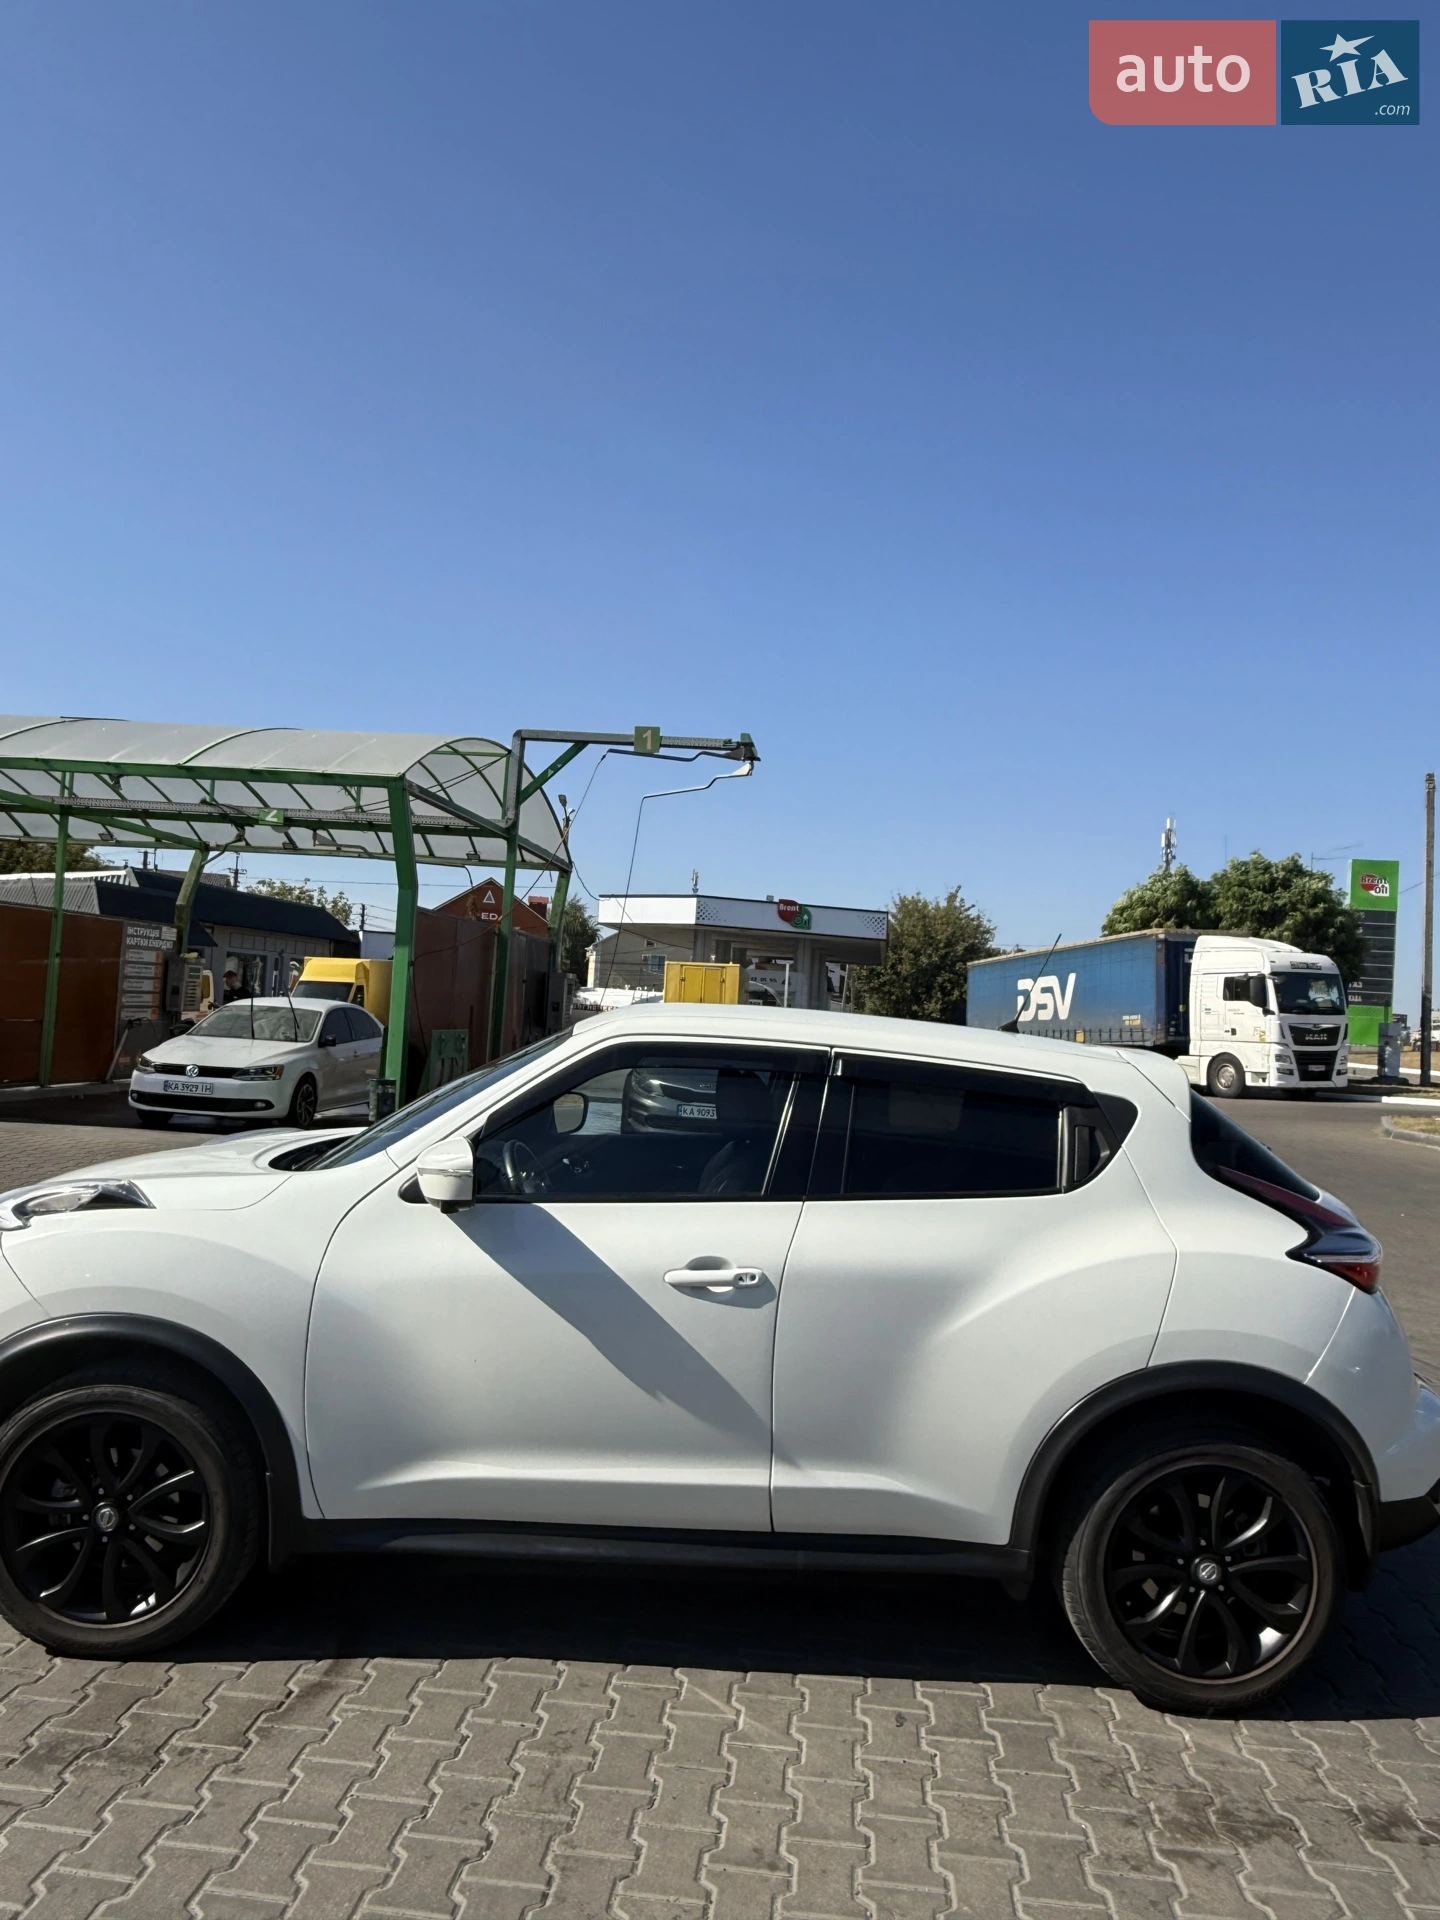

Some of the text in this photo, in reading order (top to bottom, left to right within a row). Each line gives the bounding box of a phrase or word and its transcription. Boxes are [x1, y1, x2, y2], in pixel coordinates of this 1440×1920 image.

[642, 729, 652, 750] 1
[1361, 875, 1389, 884] Brent
[779, 903, 800, 912] Brent
[1016, 972, 1077, 1022] DSV
[168, 1081, 179, 1091] KA
[683, 1107, 695, 1116] KA
